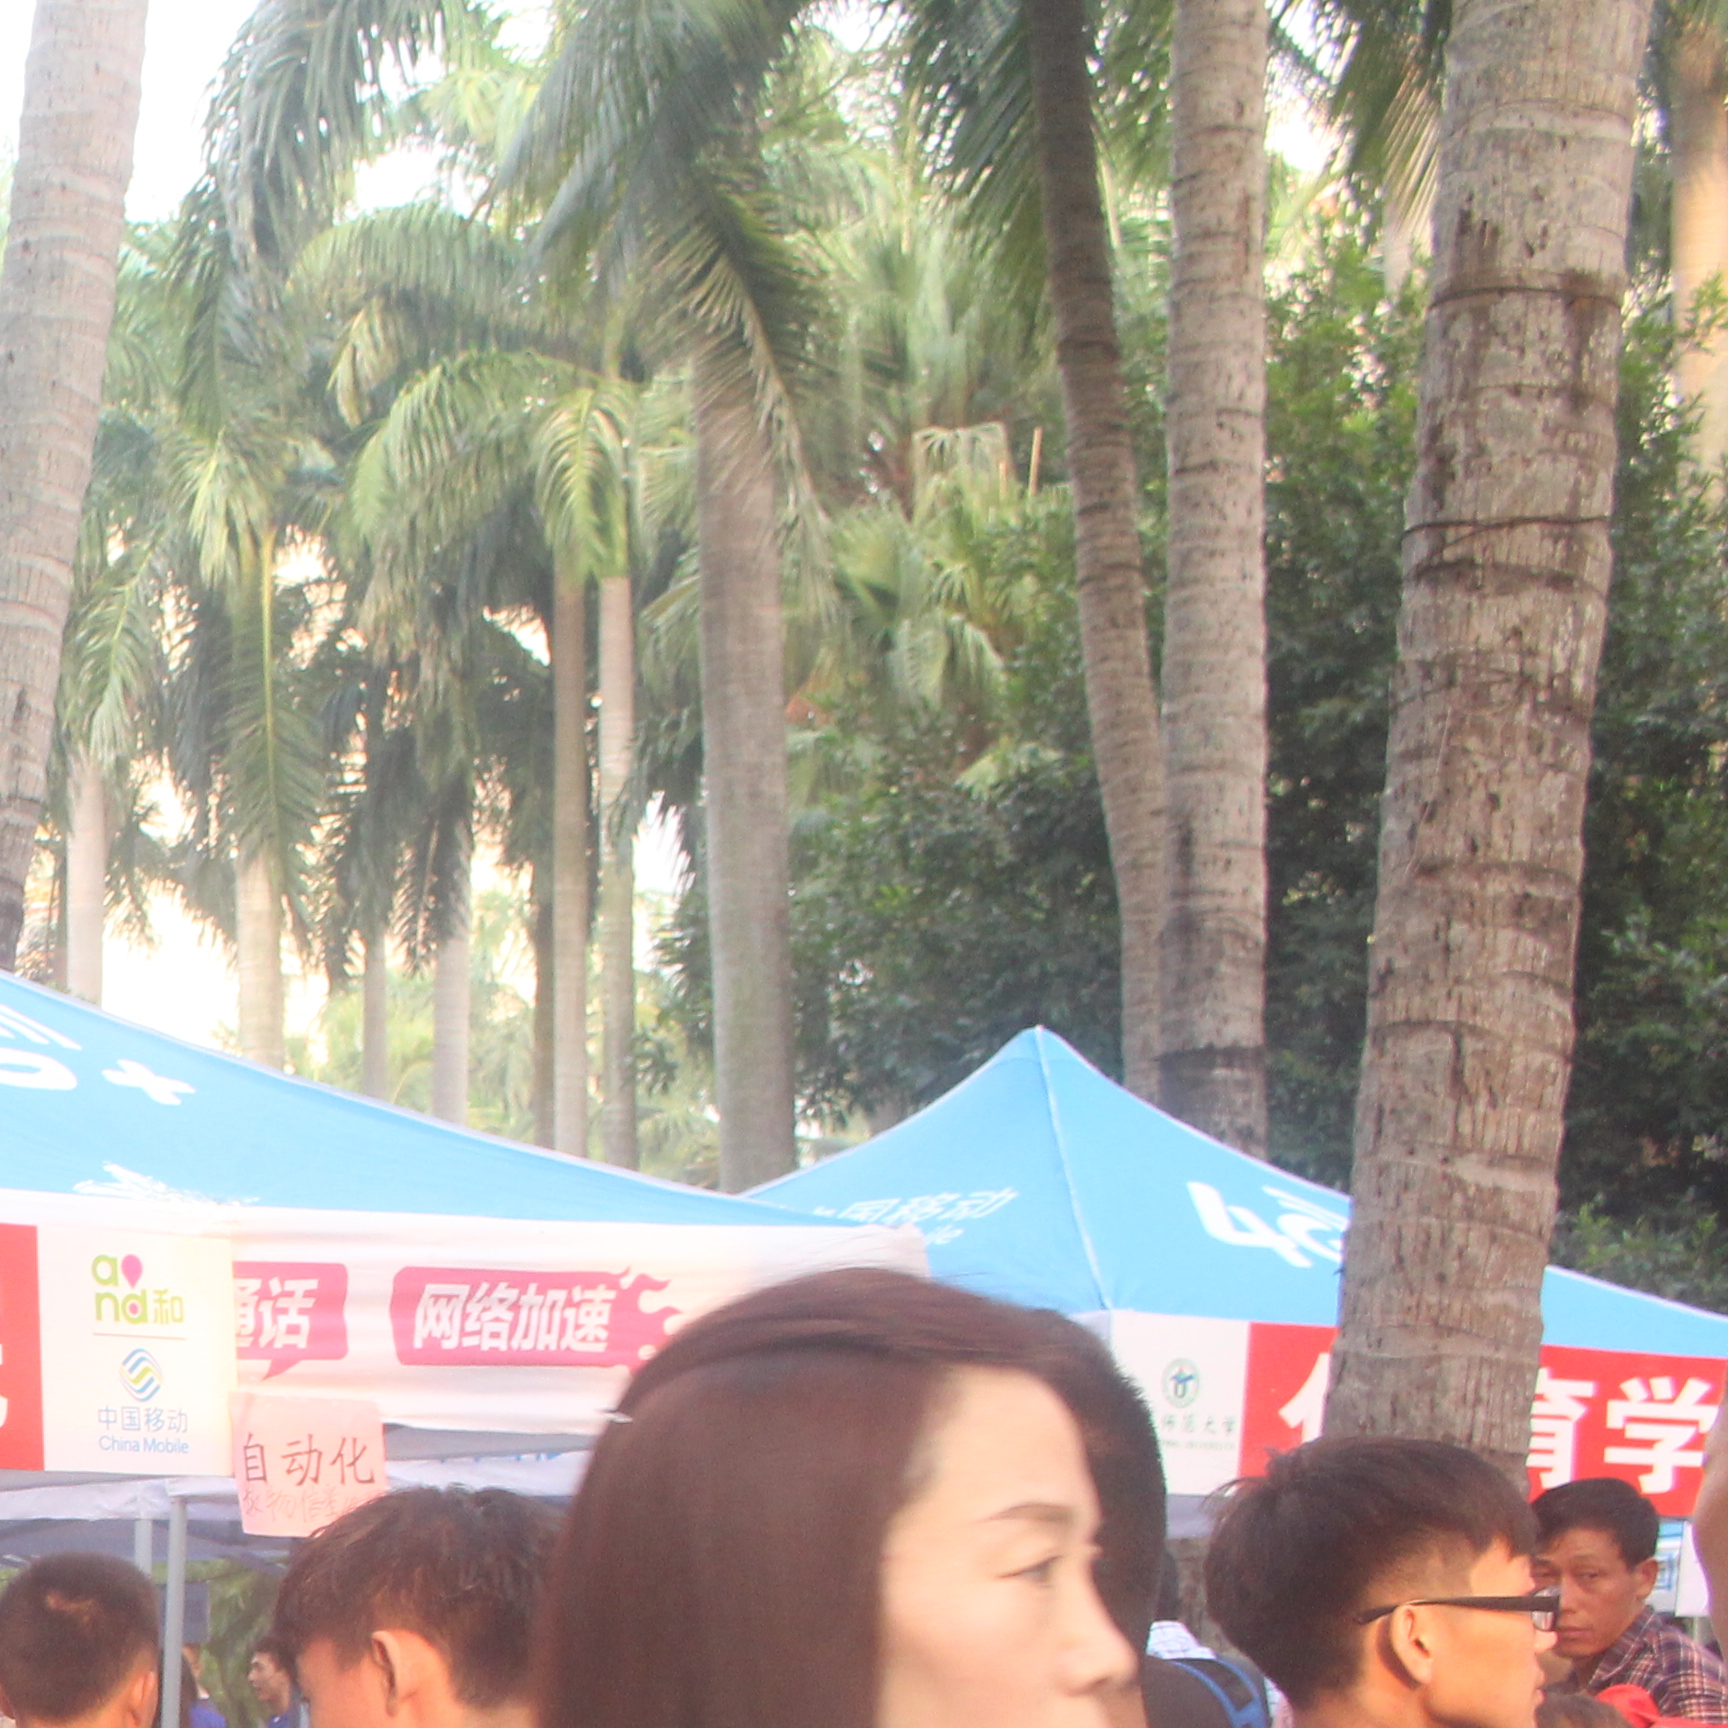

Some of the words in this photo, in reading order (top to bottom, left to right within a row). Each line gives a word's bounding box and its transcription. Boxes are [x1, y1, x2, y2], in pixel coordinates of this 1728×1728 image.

[812, 1187, 1020, 1224] 国移动
[412, 1281, 618, 1354] 网络加速
[97, 1405, 188, 1434] 中国移动
[99, 1434, 141, 1453] China
[143, 1436, 190, 1455] Mobile
[242, 1432, 376, 1487] 自动化
